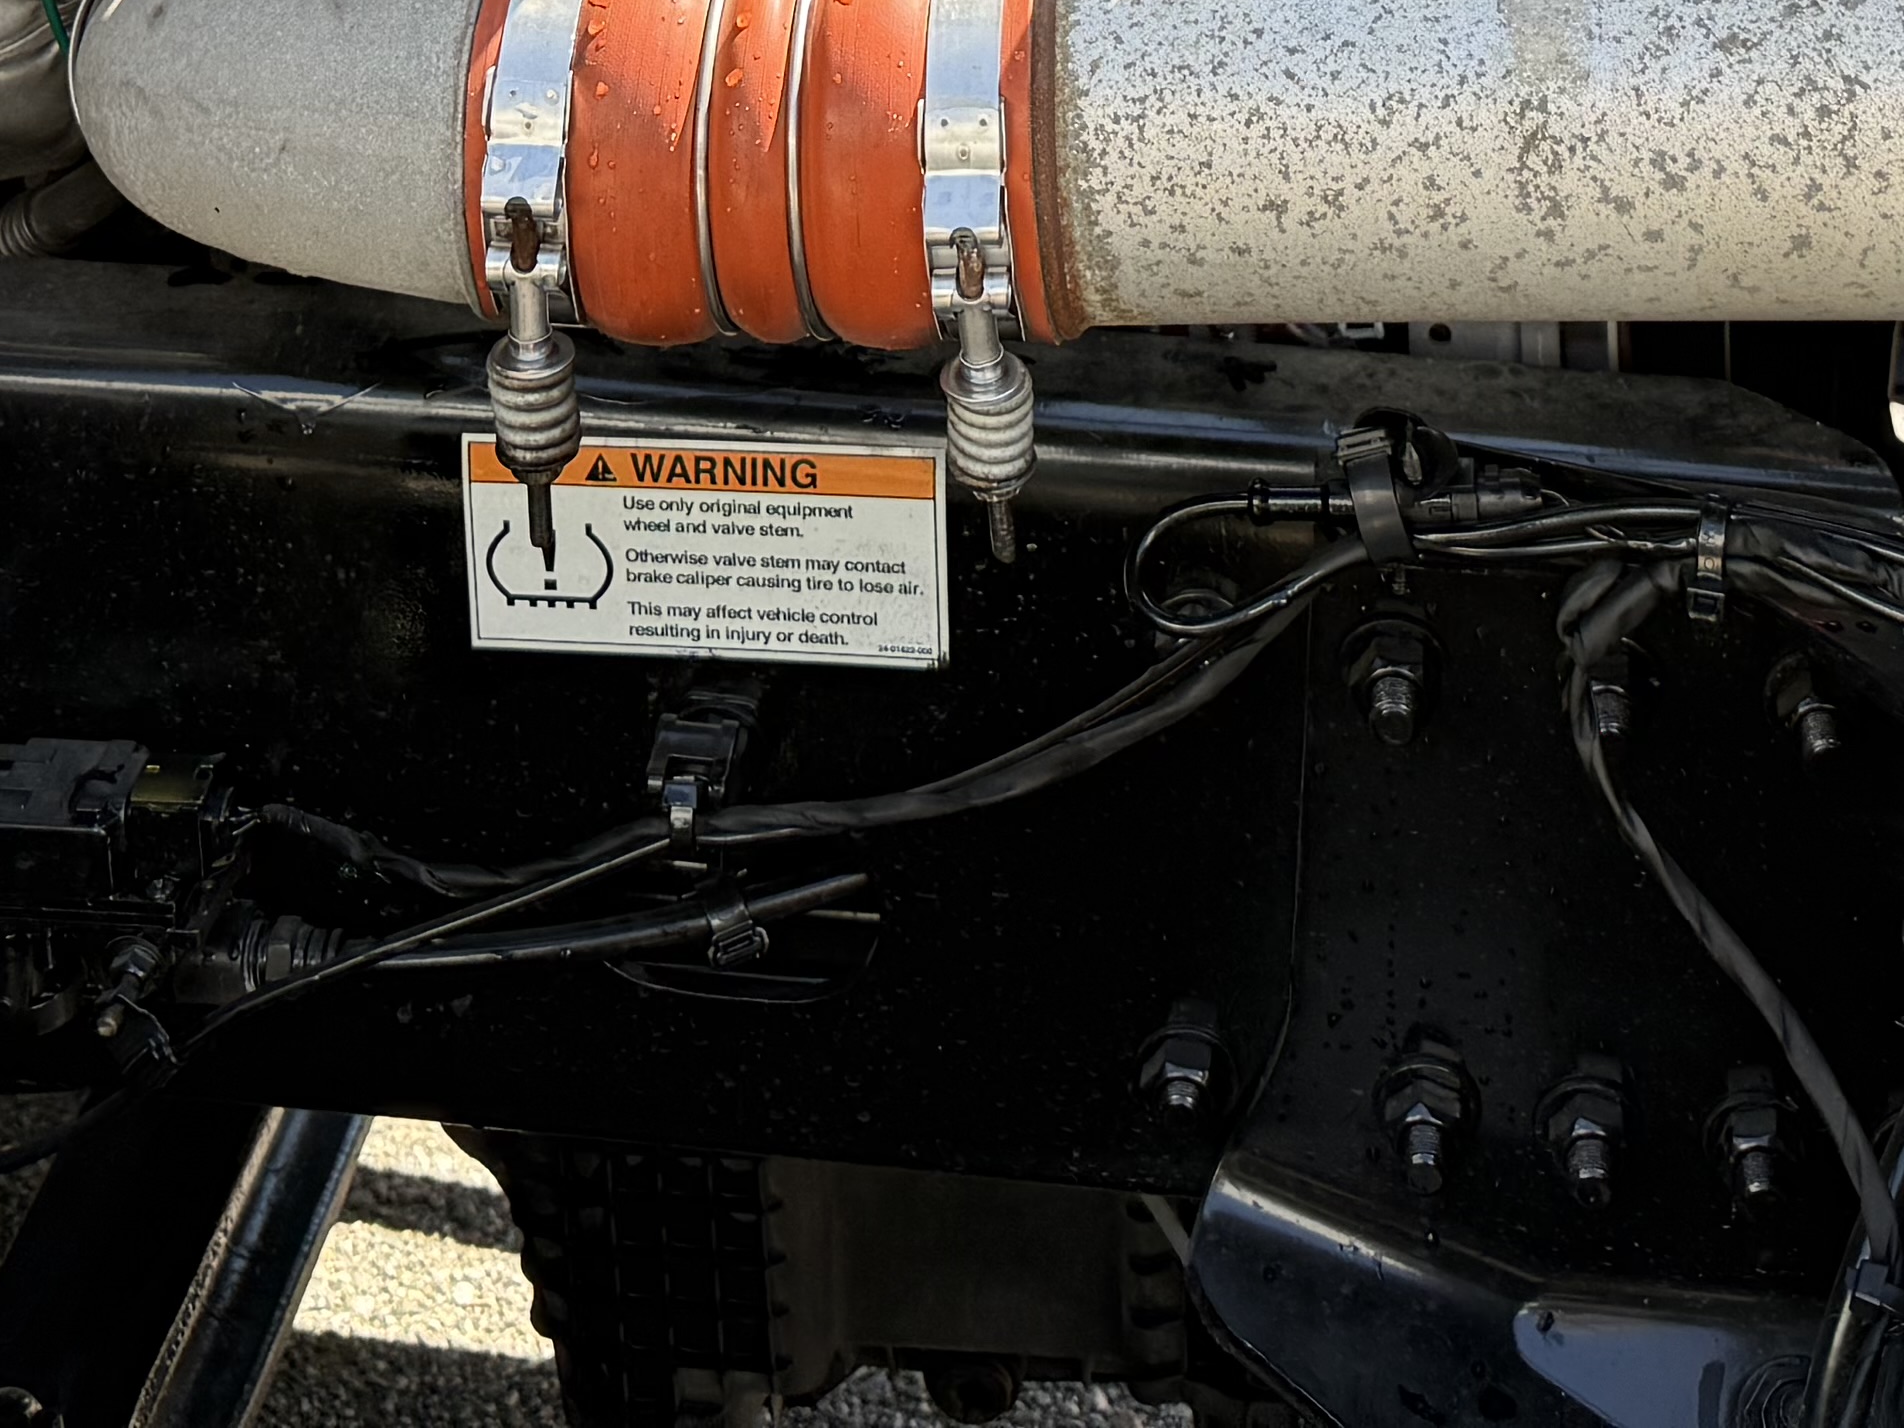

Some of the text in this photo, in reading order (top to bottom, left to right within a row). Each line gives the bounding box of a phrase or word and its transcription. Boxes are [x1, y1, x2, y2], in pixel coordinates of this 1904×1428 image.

[630, 453, 818, 489] WARNING
[623, 495, 853, 520] Use only original equipment
[623, 517, 804, 538] wheel and valve stem.
[625, 548, 906, 575] Otherwise valve stem may contact
[626, 567, 925, 595] brake caliper causing tire to lose air.
[627, 601, 878, 626] This may affect vehicle control
[629, 624, 849, 645] resulting in injury or death.
